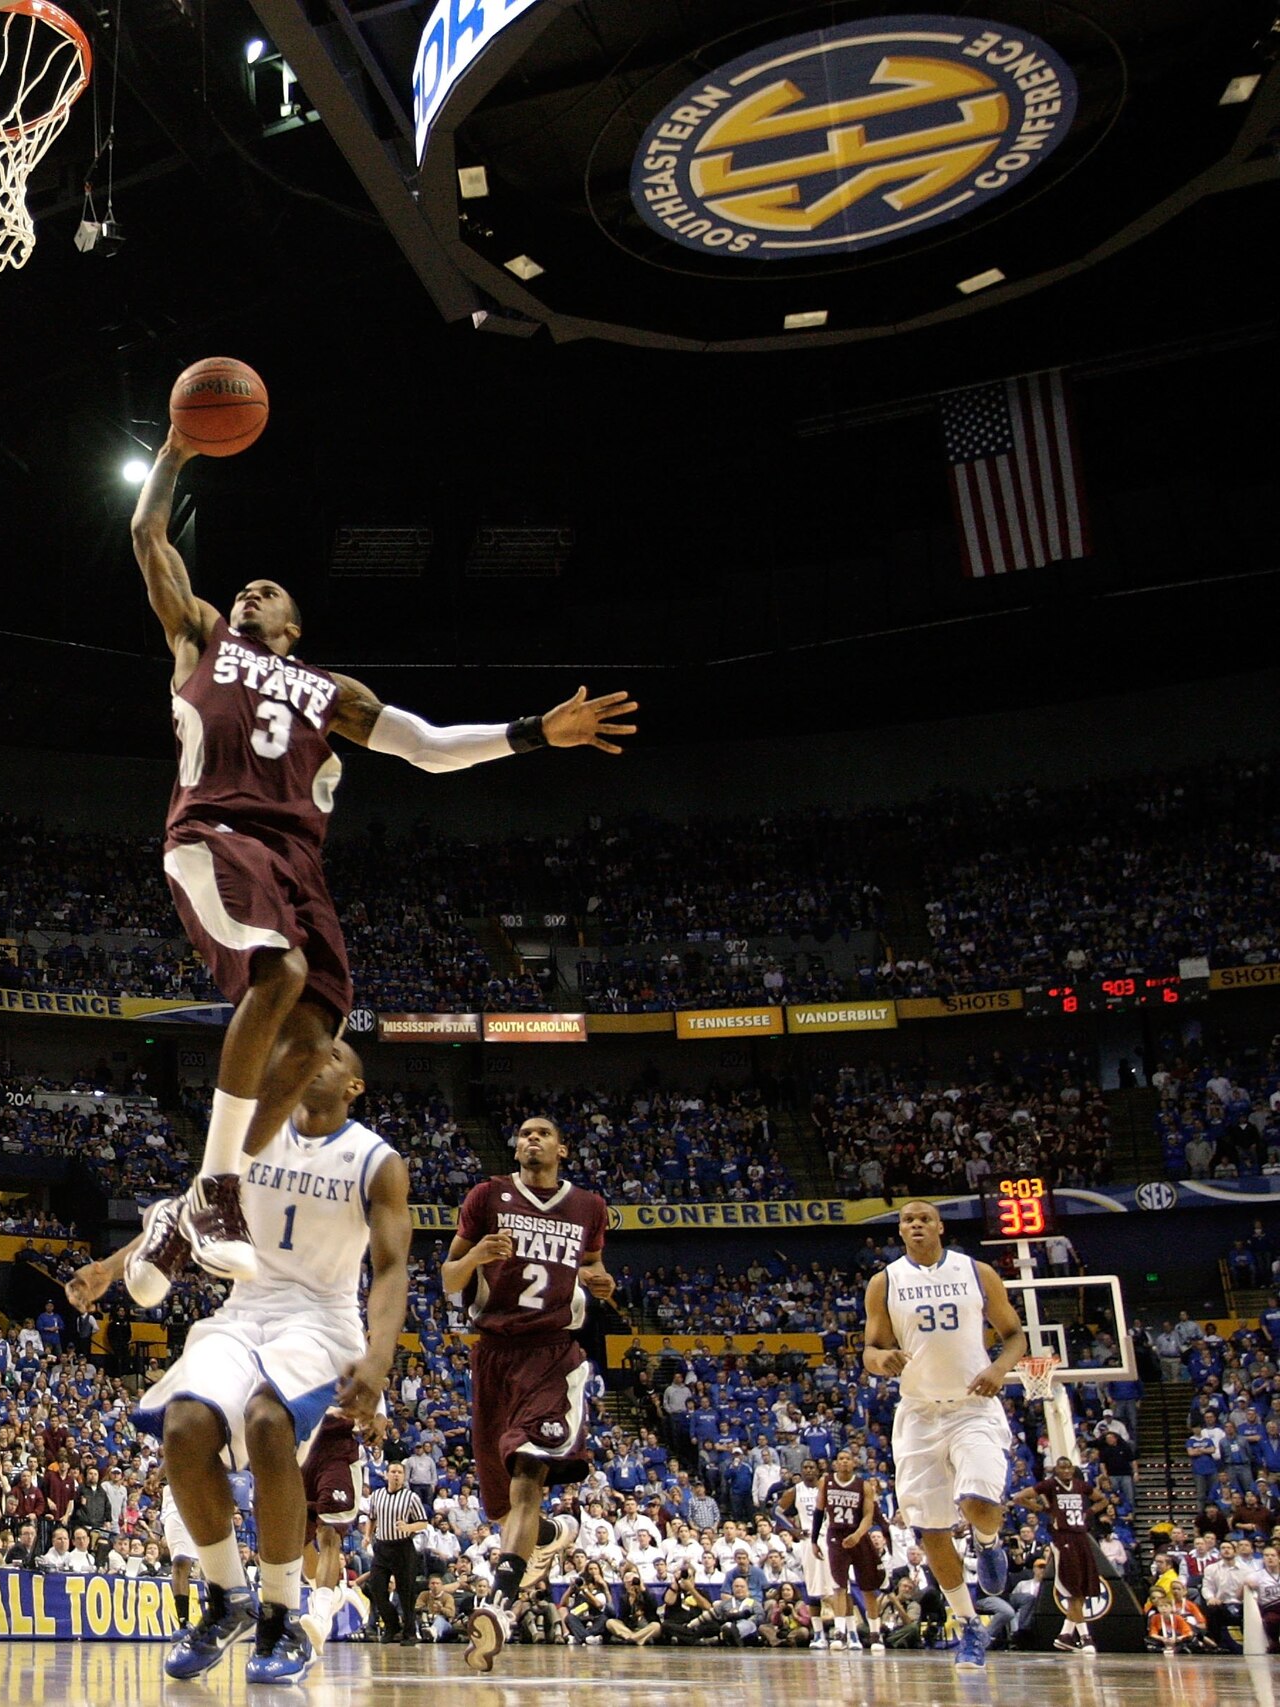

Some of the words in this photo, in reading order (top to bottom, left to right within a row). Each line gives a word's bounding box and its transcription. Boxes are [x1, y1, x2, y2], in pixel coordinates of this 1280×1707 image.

[962, 29, 1062, 191] CONFERENCE
[642, 83, 760, 253] SOUTHEASTERN
[183, 378, 252, 397] Wilson
[219, 641, 337, 698] MISSISSIPPI
[214, 656, 330, 729] STATE
[251, 700, 293, 760] 3
[500, 914, 523, 928] 303
[544, 914, 567, 928] 302
[945, 993, 1010, 1012] SHOTS
[347, 1009, 376, 1033] SEC
[383, 1021, 444, 1033] MISSISSIPPI
[446, 1021, 477, 1033] STATE
[488, 1021, 523, 1033] SOUTH
[526, 1021, 580, 1033] CAROLINA
[688, 1014, 771, 1030] TENNESSEE
[795, 1008, 888, 1024] VANDERBILT
[5, 1083, 32, 1107] 204
[247, 1160, 355, 1203] KENTUCKY
[999, 1177, 1044, 1198] 9:03
[1138, 1182, 1173, 1210] SEC
[636, 1202, 845, 1226] CONFERENCE
[998, 1199, 1044, 1234] 33
[279, 1204, 297, 1250] 1
[497, 1212, 584, 1241] MISSISSIPPI
[511, 1228, 582, 1269] TATE
[518, 1262, 568, 1310] 2
[898, 1282, 969, 1301] KENTUCKY
[915, 1303, 959, 1333] 33
[833, 1506, 854, 1524] 24
[1065, 1510, 1085, 1526] 32
